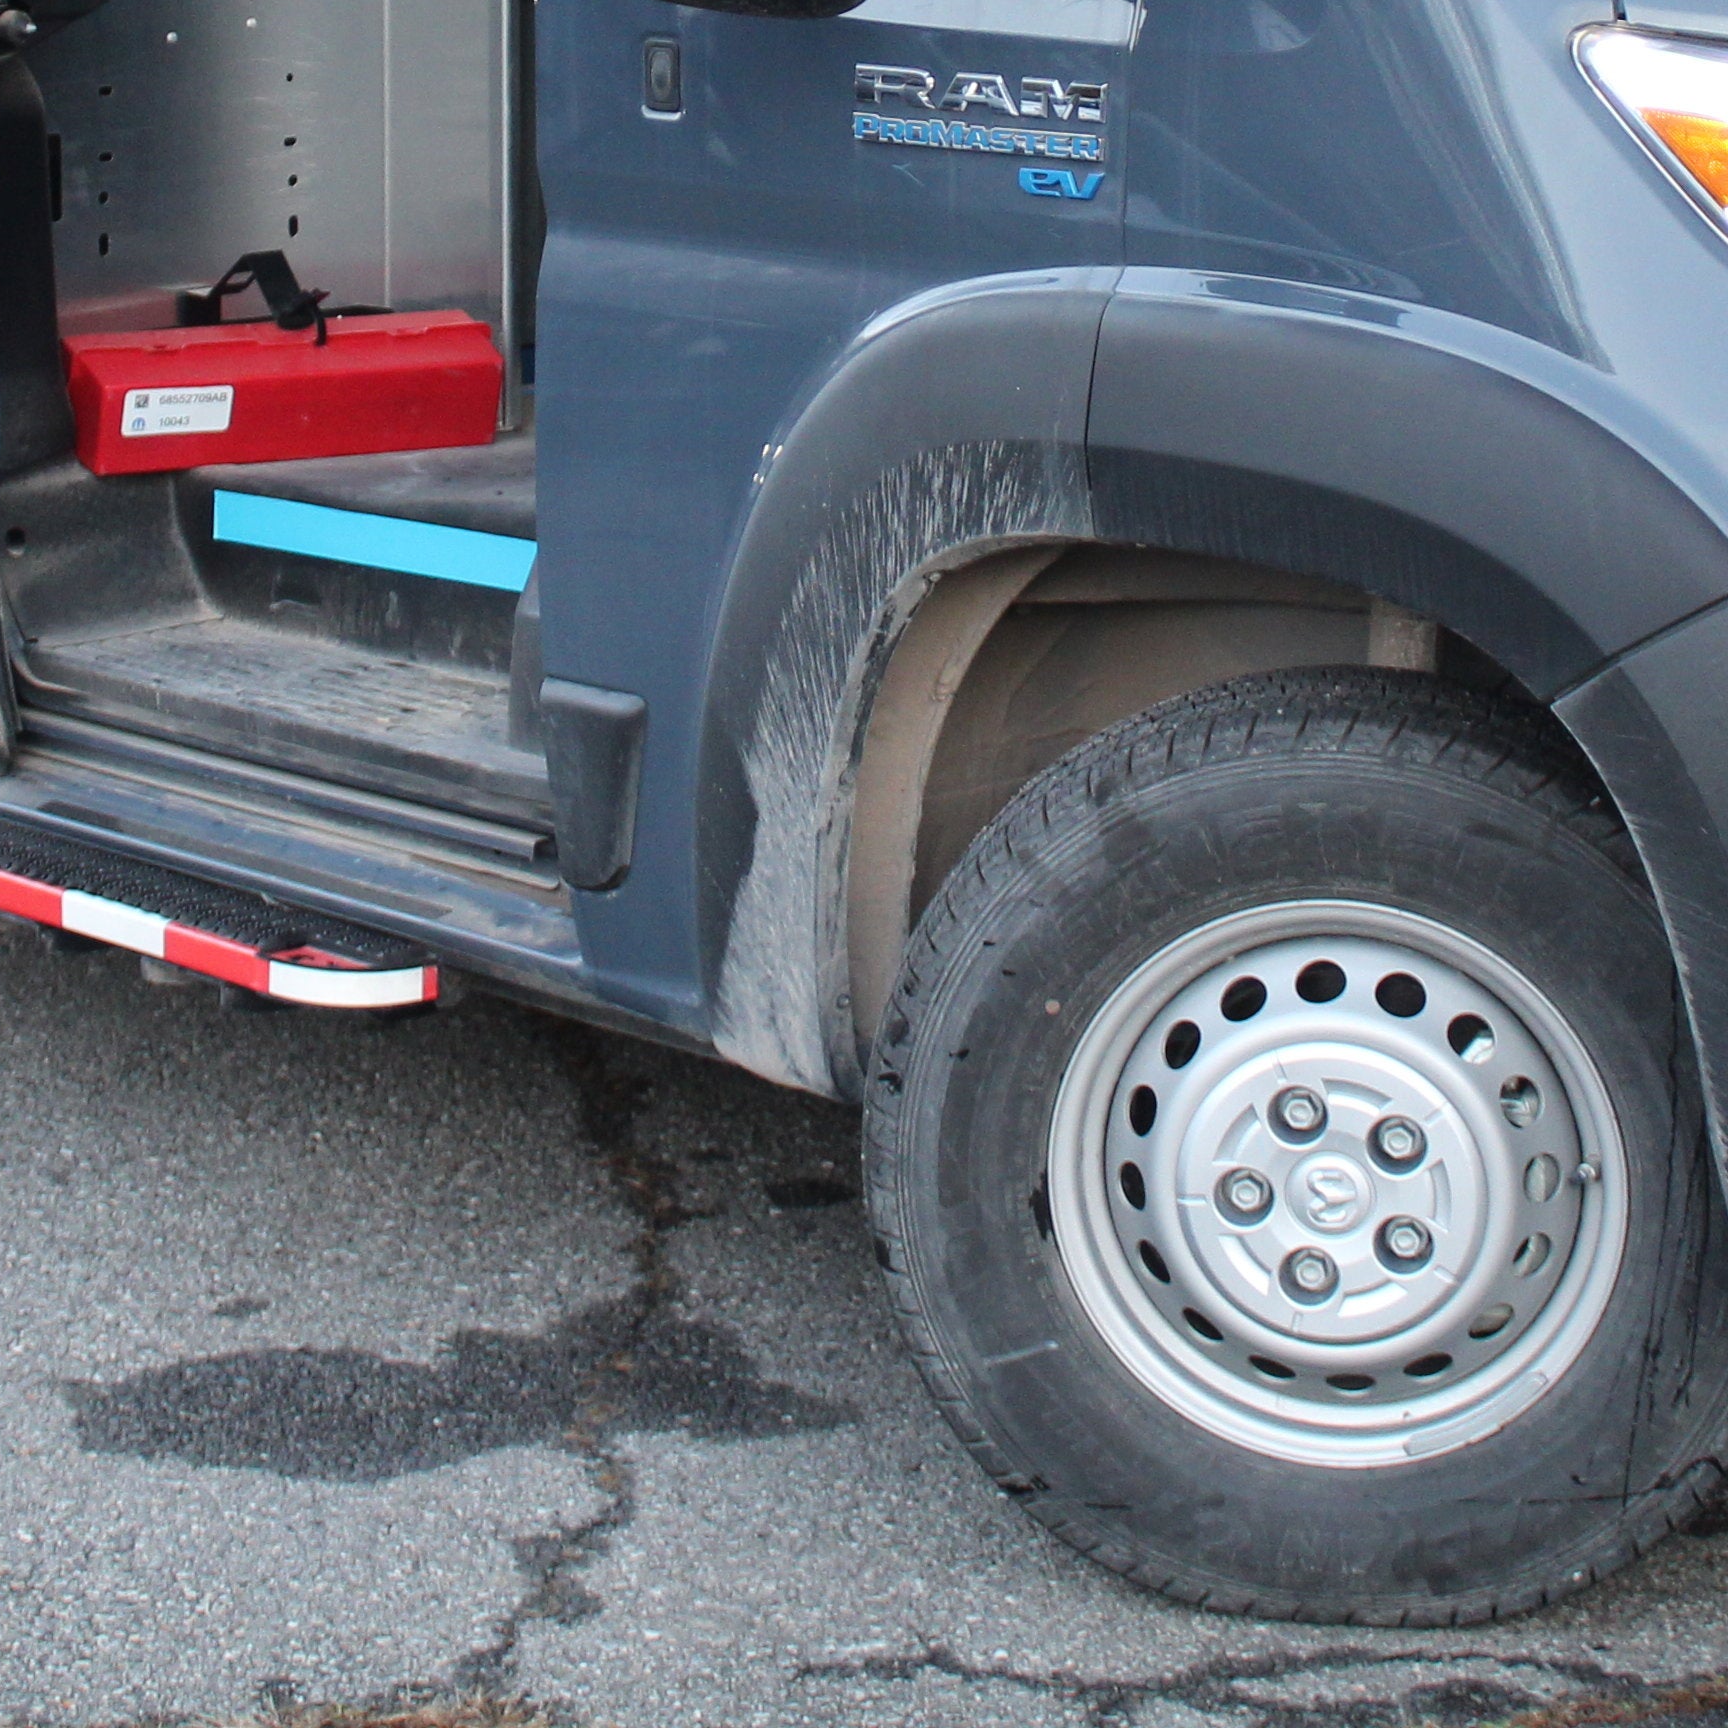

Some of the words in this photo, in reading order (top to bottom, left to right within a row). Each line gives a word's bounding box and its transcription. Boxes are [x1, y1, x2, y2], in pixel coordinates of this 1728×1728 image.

[854, 62, 1108, 124] RAM
[852, 111, 1106, 162] PROMASTER
[159, 392, 228, 405] 68552709AB
[159, 415, 190, 427] 10043
